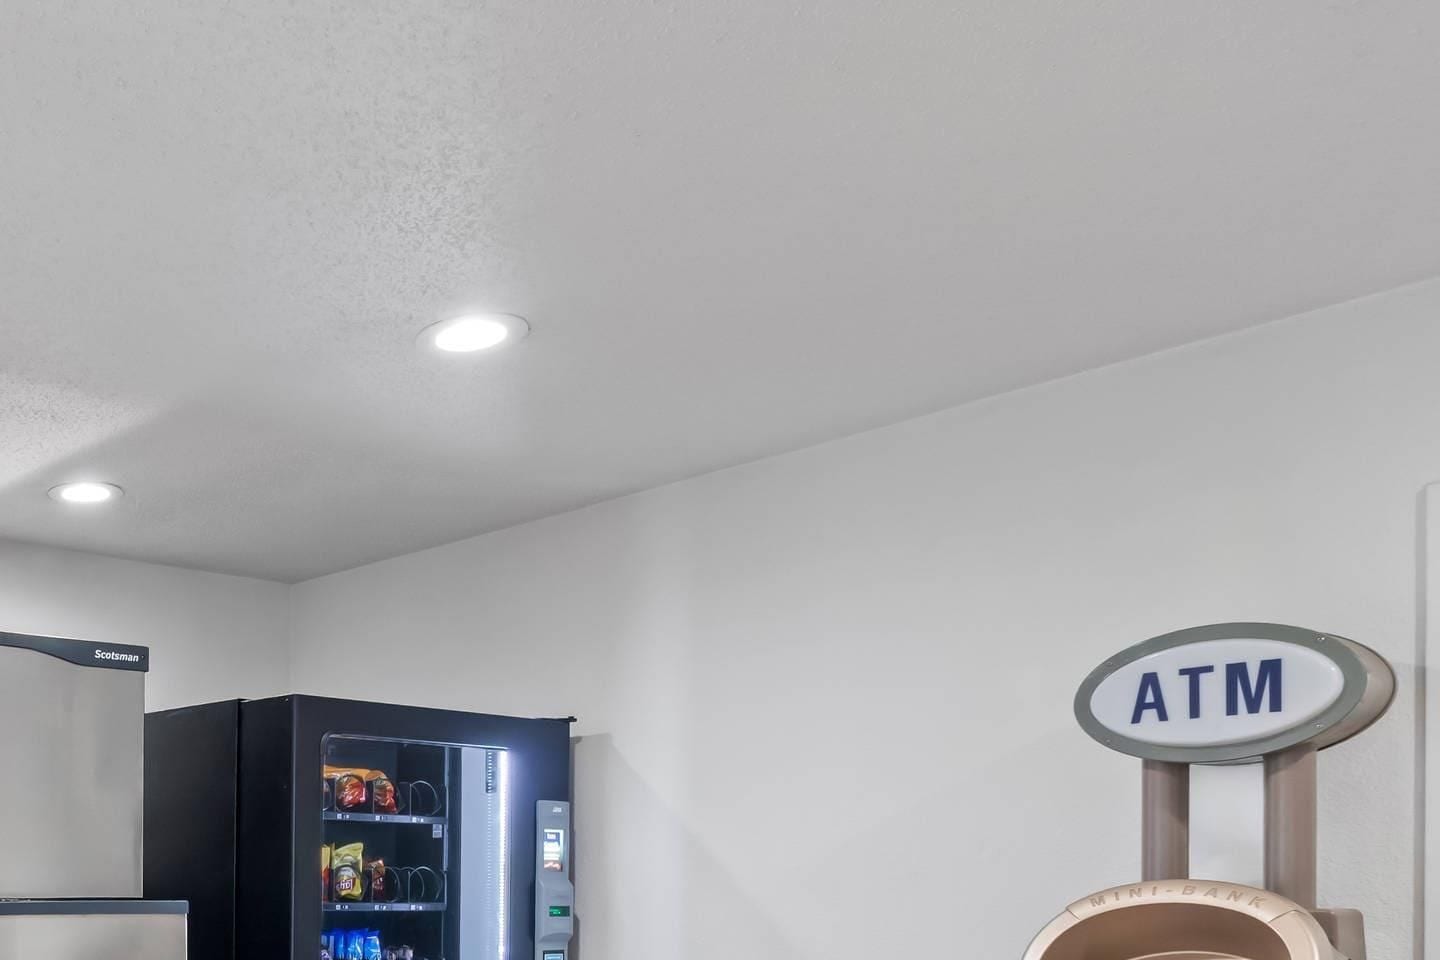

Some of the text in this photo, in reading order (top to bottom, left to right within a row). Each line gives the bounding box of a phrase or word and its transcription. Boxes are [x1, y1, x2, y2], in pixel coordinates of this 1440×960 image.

[94, 649, 139, 662] Scotsman
[1131, 658, 1282, 724] ATM
[1089, 884, 1266, 908] MINI-BANK
